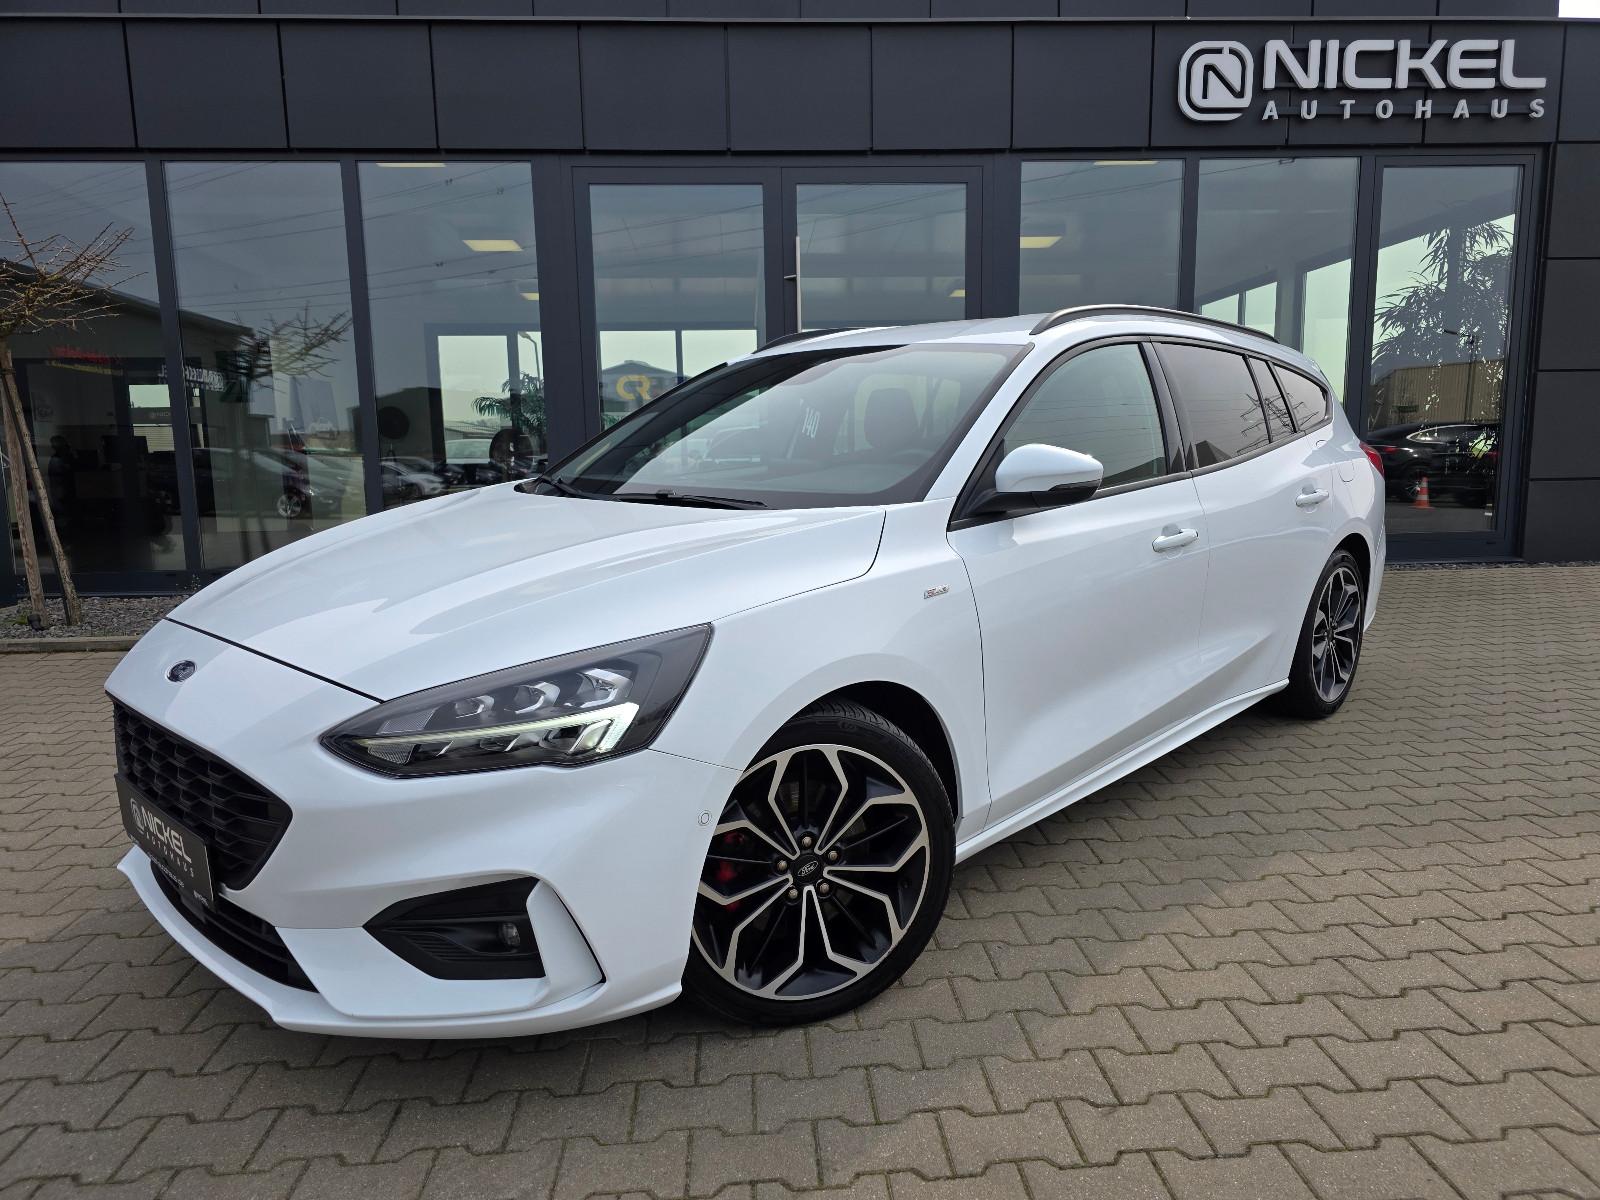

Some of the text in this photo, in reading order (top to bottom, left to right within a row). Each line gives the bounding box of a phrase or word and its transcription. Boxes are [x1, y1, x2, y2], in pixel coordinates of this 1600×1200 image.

[1262, 39, 1547, 89] NICKEL
[1262, 98, 1546, 121] AUTOHAUS
[141, 806, 192, 864] NICKEL
